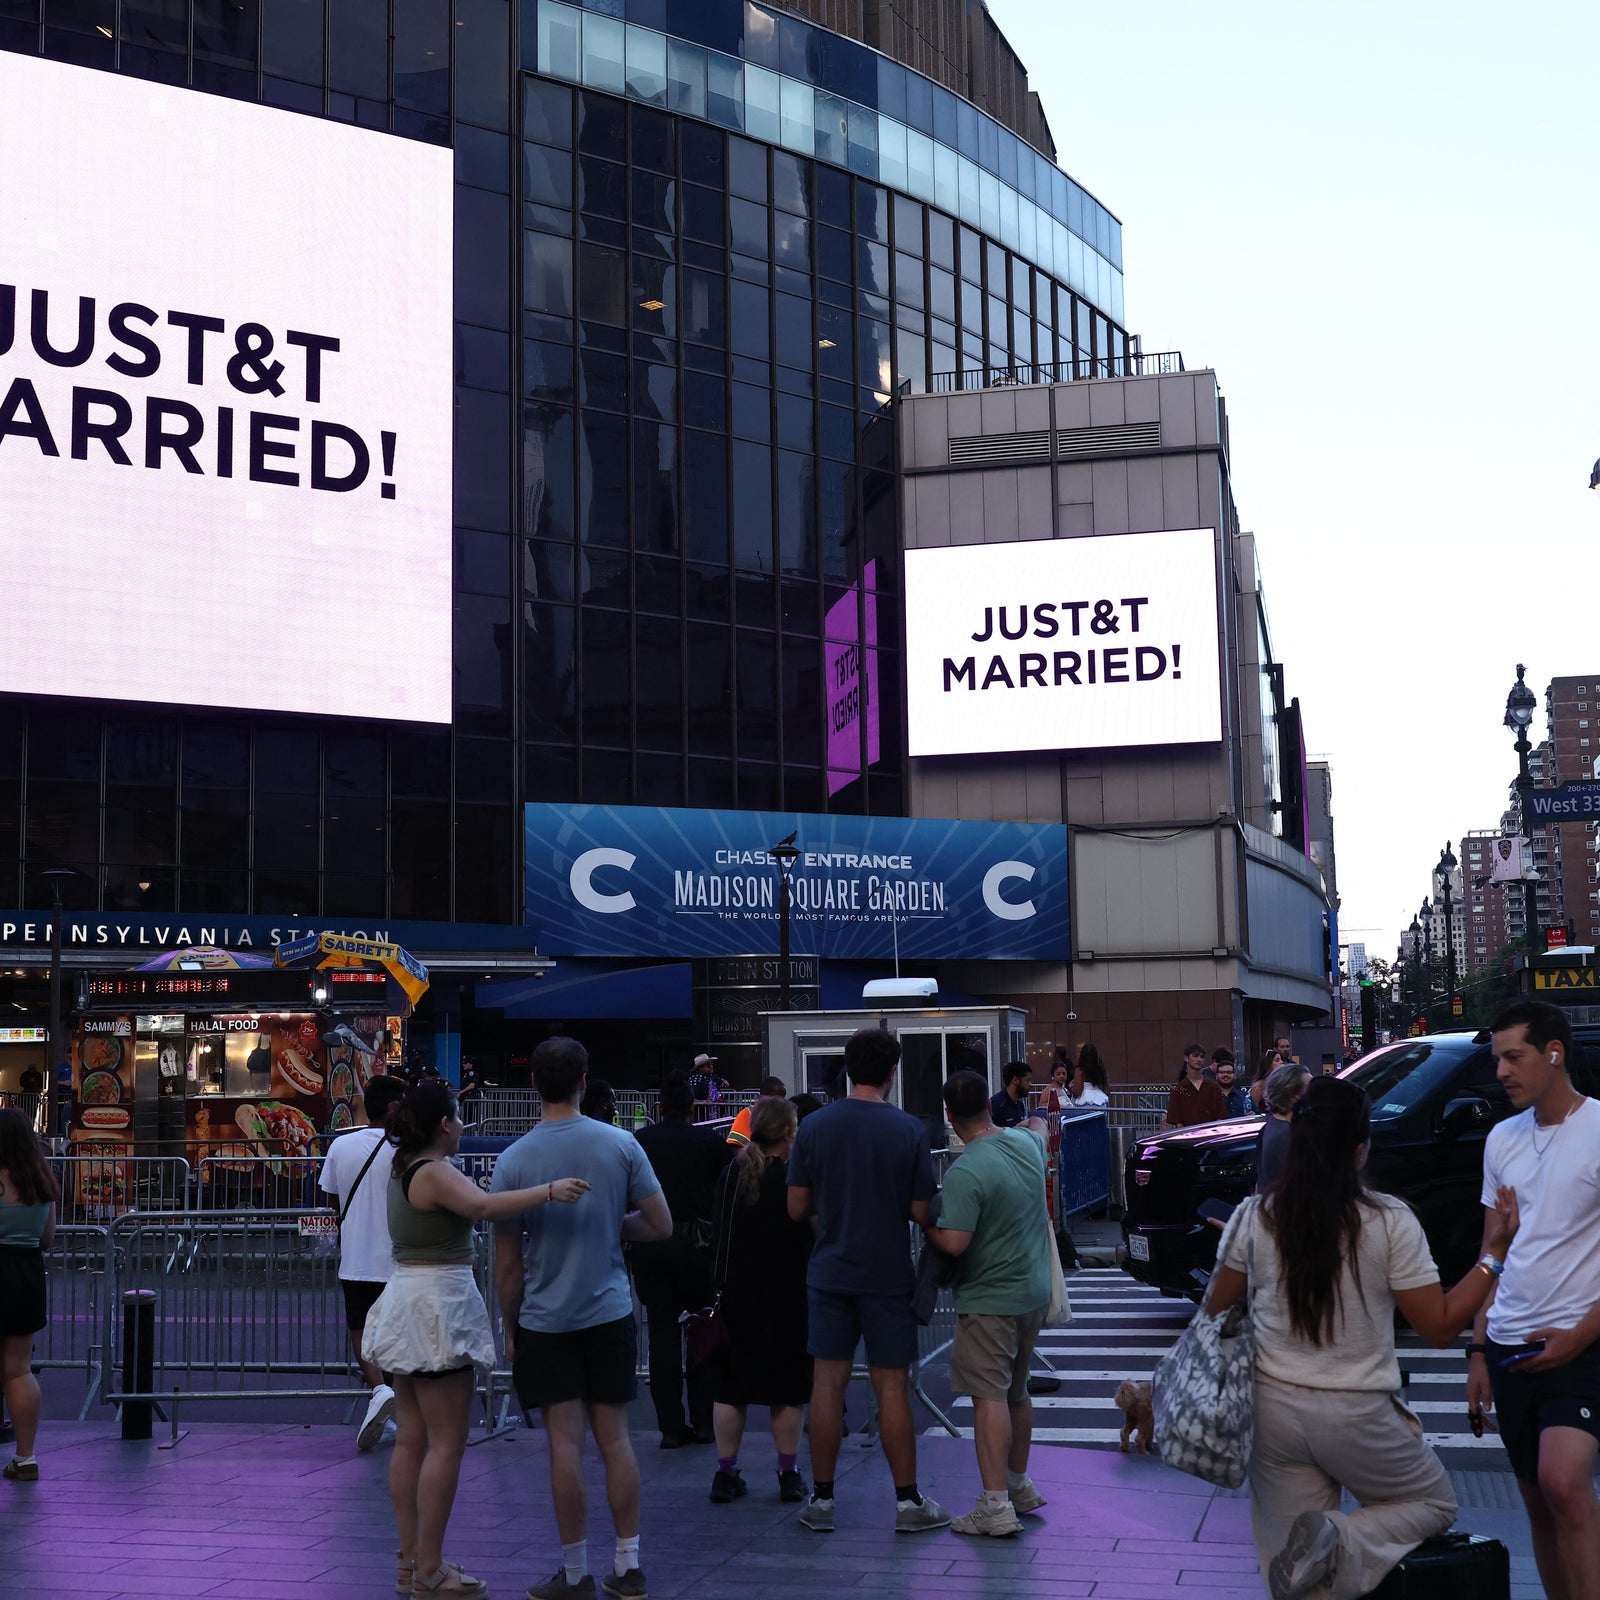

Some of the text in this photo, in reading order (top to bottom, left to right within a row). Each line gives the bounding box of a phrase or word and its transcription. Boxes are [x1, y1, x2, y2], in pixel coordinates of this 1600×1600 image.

[0, 283, 340, 404] JUST&T
[971, 597, 1149, 642] JUST&T
[943, 644, 1181, 692] MARRIED!
[1533, 797, 1579, 814] West
[715, 849, 913, 869] CHASE ENTRANCE
[569, 847, 637, 914] C
[674, 869, 945, 912] MADISON SQUARE GARDEN
[982, 859, 1037, 921] C
[718, 911, 739, 919] THE
[743, 912, 791, 920] WORLD
[795, 913, 825, 921] MOST
[828, 914, 870, 922] FAMOUS
[270, 927, 389, 947] STAON
[324, 937, 394, 958] SABRETT
[763, 960, 813, 981] STTION
[84, 1021, 132, 1032] SAMMY'S
[190, 1019, 259, 1031] HALAL FOOD
